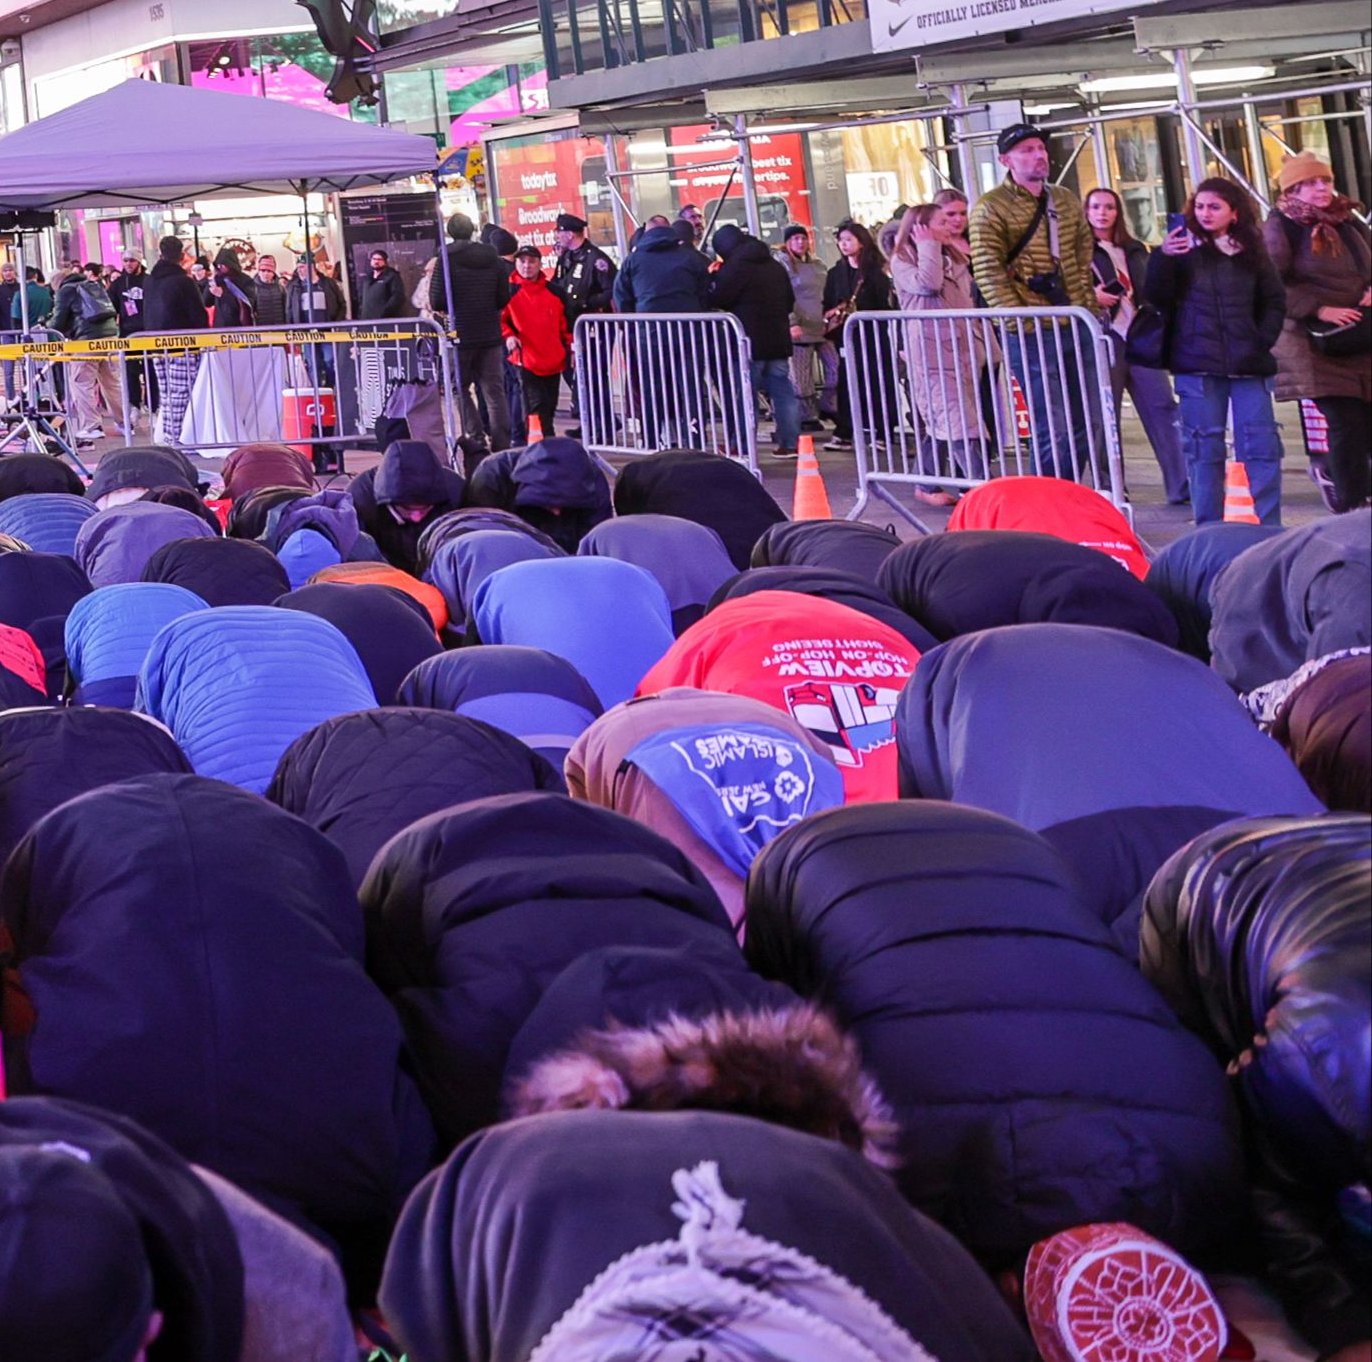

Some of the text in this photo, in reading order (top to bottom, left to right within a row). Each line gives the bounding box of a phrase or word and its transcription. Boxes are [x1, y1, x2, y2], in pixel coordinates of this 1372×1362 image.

[916, 3, 968, 29] OFFICIALLY
[777, 155, 792, 168] tix
[22, 342, 64, 354] CAUTION
[88, 339, 130, 351] CAUTION
[155, 336, 197, 347] CAUTION
[220, 333, 262, 345] CAUTION
[285, 331, 326, 343] CAUTION
[773, 639, 884, 652] SIGHTSEEING
[762, 650, 908, 667] HOP-ON HOP-OFF
[779, 660, 912, 678] TOPVIEW
[704, 738, 774, 769] ISLAMIC
